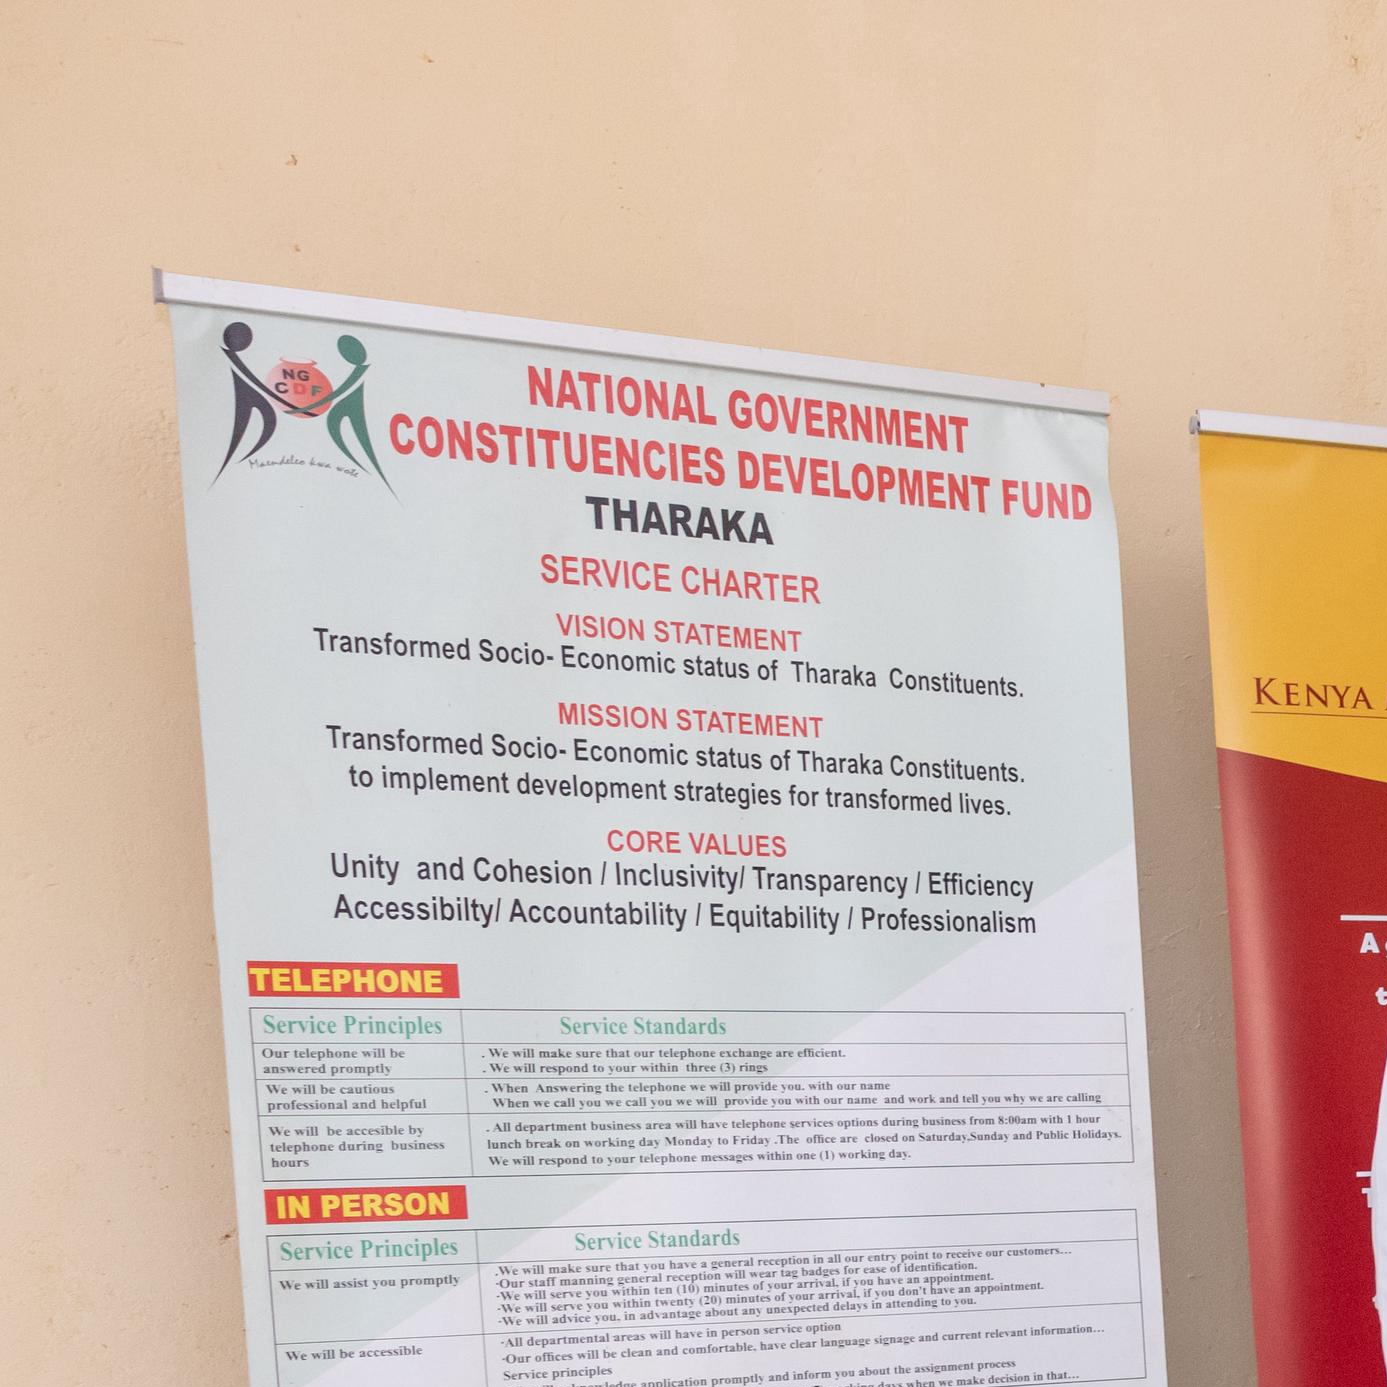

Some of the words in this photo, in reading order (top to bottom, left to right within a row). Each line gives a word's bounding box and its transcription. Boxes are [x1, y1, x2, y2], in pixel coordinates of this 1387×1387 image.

[282, 368, 310, 381] NG
[527, 365, 717, 426] NATIONAL
[728, 389, 969, 454] GOVERNMENT
[389, 413, 725, 487] CONSTITUENCIES
[737, 450, 990, 513] DEVELOPMENT
[1002, 479, 1092, 520] FUND
[585, 495, 774, 546] THARAKA
[541, 553, 672, 592] SERVICE
[681, 565, 821, 604] CHARTER
[555, 613, 645, 641] VISION
[654, 620, 802, 652] STATEMENT
[313, 627, 471, 661] Transformed
[561, 645, 676, 674] Economic
[683, 655, 750, 680] status
[757, 659, 778, 681] of
[790, 660, 877, 688] Tharaka
[889, 667, 1023, 698] Constituents.
[1254, 677, 1374, 710] KENYA
[558, 702, 667, 730] MISSION
[676, 708, 823, 738] STATEMENT
[325, 724, 483, 756] Transformed
[573, 738, 688, 766] Economic
[696, 746, 762, 770] status
[770, 749, 791, 771] of
[797, 750, 883, 775] Tharaka
[890, 755, 1024, 783] Constituents.
[348, 765, 373, 788] to
[382, 765, 510, 796] implement
[517, 772, 667, 804] development
[674, 780, 782, 810] strategies
[788, 784, 819, 807] for
[825, 787, 952, 813] transformed
[959, 792, 1011, 816] lives.
[607, 829, 682, 854] CORE
[688, 832, 787, 858] VALUES
[331, 852, 400, 886] Unity
[417, 856, 464, 881] and
[473, 857, 592, 885] Cohesion
[752, 866, 908, 899] Transparency
[928, 871, 1034, 903] Efficiency
[509, 898, 687, 932] Accountability
[710, 903, 840, 935] Equitability
[861, 907, 1036, 934] Professionalism
[1359, 932, 1380, 954] A
[247, 966, 443, 997] TELEPHONE
[263, 1014, 337, 1034] Service
[343, 1015, 442, 1040] Principles
[560, 1016, 628, 1035] Service
[633, 1016, 726, 1035] Standards
[261, 1048, 290, 1059] Our
[293, 1047, 358, 1062] telephone
[361, 1048, 386, 1058] will
[390, 1048, 405, 1058] be
[488, 1048, 509, 1058] We
[512, 1048, 535, 1058] will
[539, 1048, 572, 1058] make
[575, 1050, 602, 1058] sure
[605, 1048, 630, 1058] that
[633, 1050, 655, 1058] our
[658, 1048, 716, 1061] telephone
[719, 1048, 773, 1060] exchange
[775, 1050, 794, 1058] are
[797, 1048, 846, 1058] efficient.
[263, 1063, 327, 1074] answered
[330, 1063, 392, 1077] promptly
[265, 1084, 288, 1095] We
[291, 1084, 316, 1095] will
[320, 1084, 336, 1095] be
[339, 1084, 395, 1095] cautious
[267, 1099, 348, 1113] professional
[352, 1099, 377, 1110] and
[381, 1098, 427, 1112] helpful
[276, 1195, 311, 1219] IN
[320, 1191, 450, 1218] PERSON
[280, 1240, 354, 1261] Service
[360, 1237, 458, 1262] Principles
[574, 1231, 642, 1251] Service
[648, 1228, 740, 1249] Standards
[279, 1280, 301, 1291] We
[304, 1279, 329, 1289] will
[333, 1277, 369, 1289] assist
[372, 1279, 396, 1290] you
[400, 1274, 460, 1289] promptly
[285, 1351, 307, 1361] We
[311, 1349, 335, 1360] will
[339, 1348, 355, 1359] be
[359, 1345, 423, 1358] accessible
